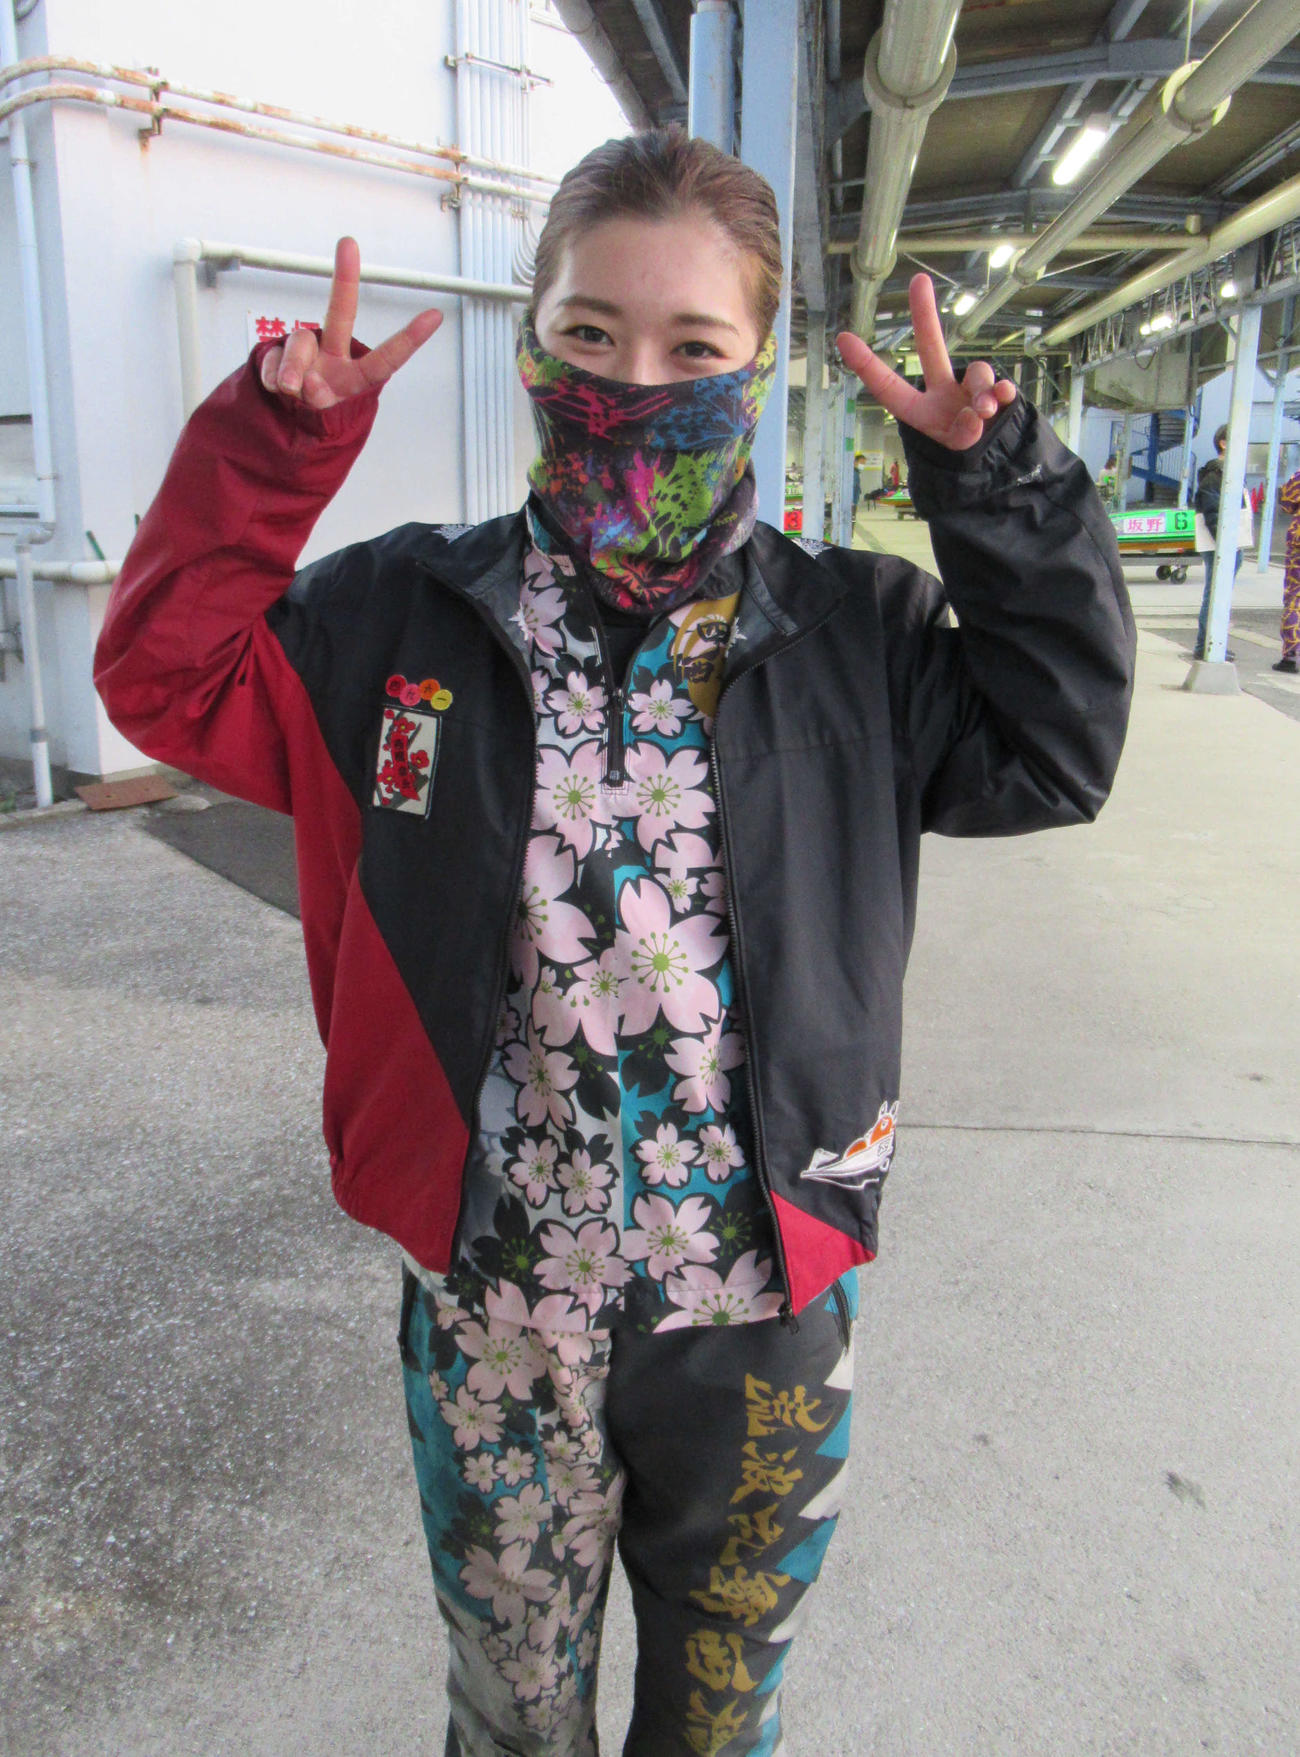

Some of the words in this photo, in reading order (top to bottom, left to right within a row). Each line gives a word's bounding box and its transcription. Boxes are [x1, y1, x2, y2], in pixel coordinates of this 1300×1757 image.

[787, 511, 798, 528] 3
[1127, 519, 1163, 533] 坂野
[1174, 512, 1188, 530] 6
